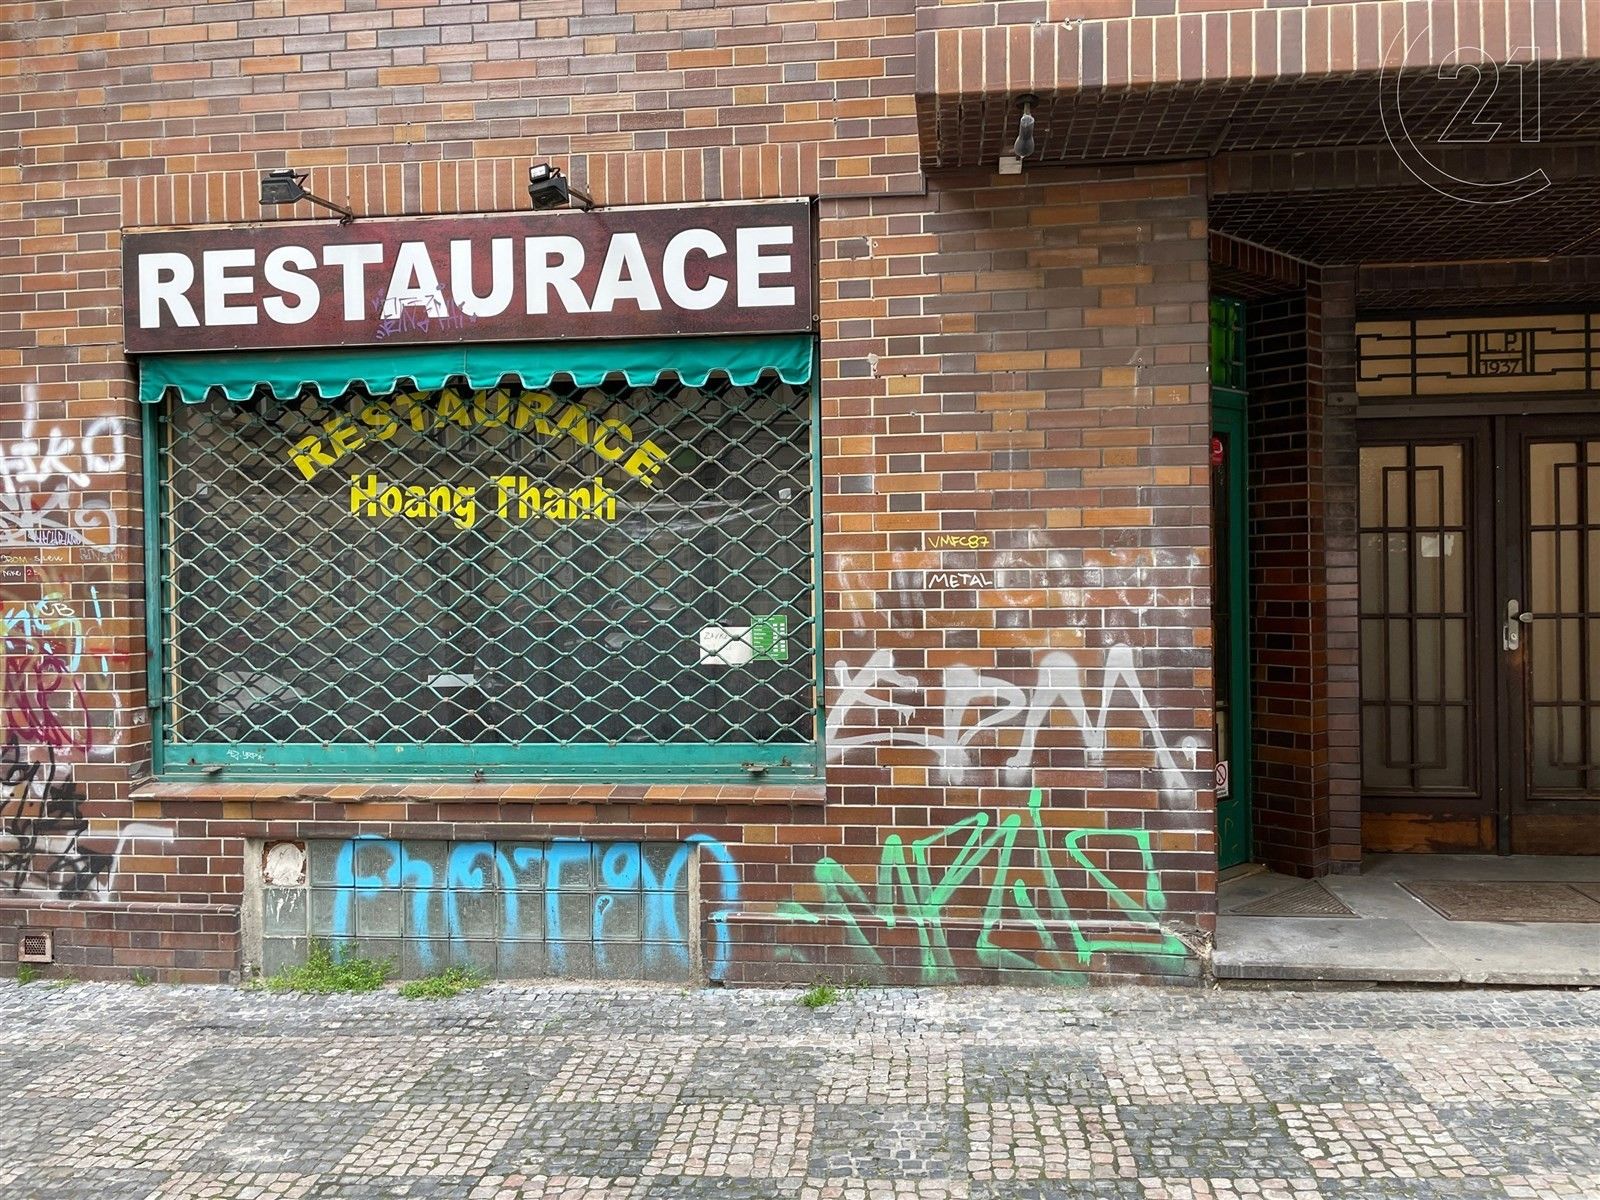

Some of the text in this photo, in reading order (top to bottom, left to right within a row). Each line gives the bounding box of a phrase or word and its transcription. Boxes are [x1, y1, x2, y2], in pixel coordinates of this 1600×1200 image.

[138, 225, 796, 329] RESTAURACE
[1480, 360, 1520, 375] 1937
[287, 388, 671, 488] RESTAURACE
[350, 474, 616, 530] Hoang Thanh
[928, 572, 993, 589] METAL
